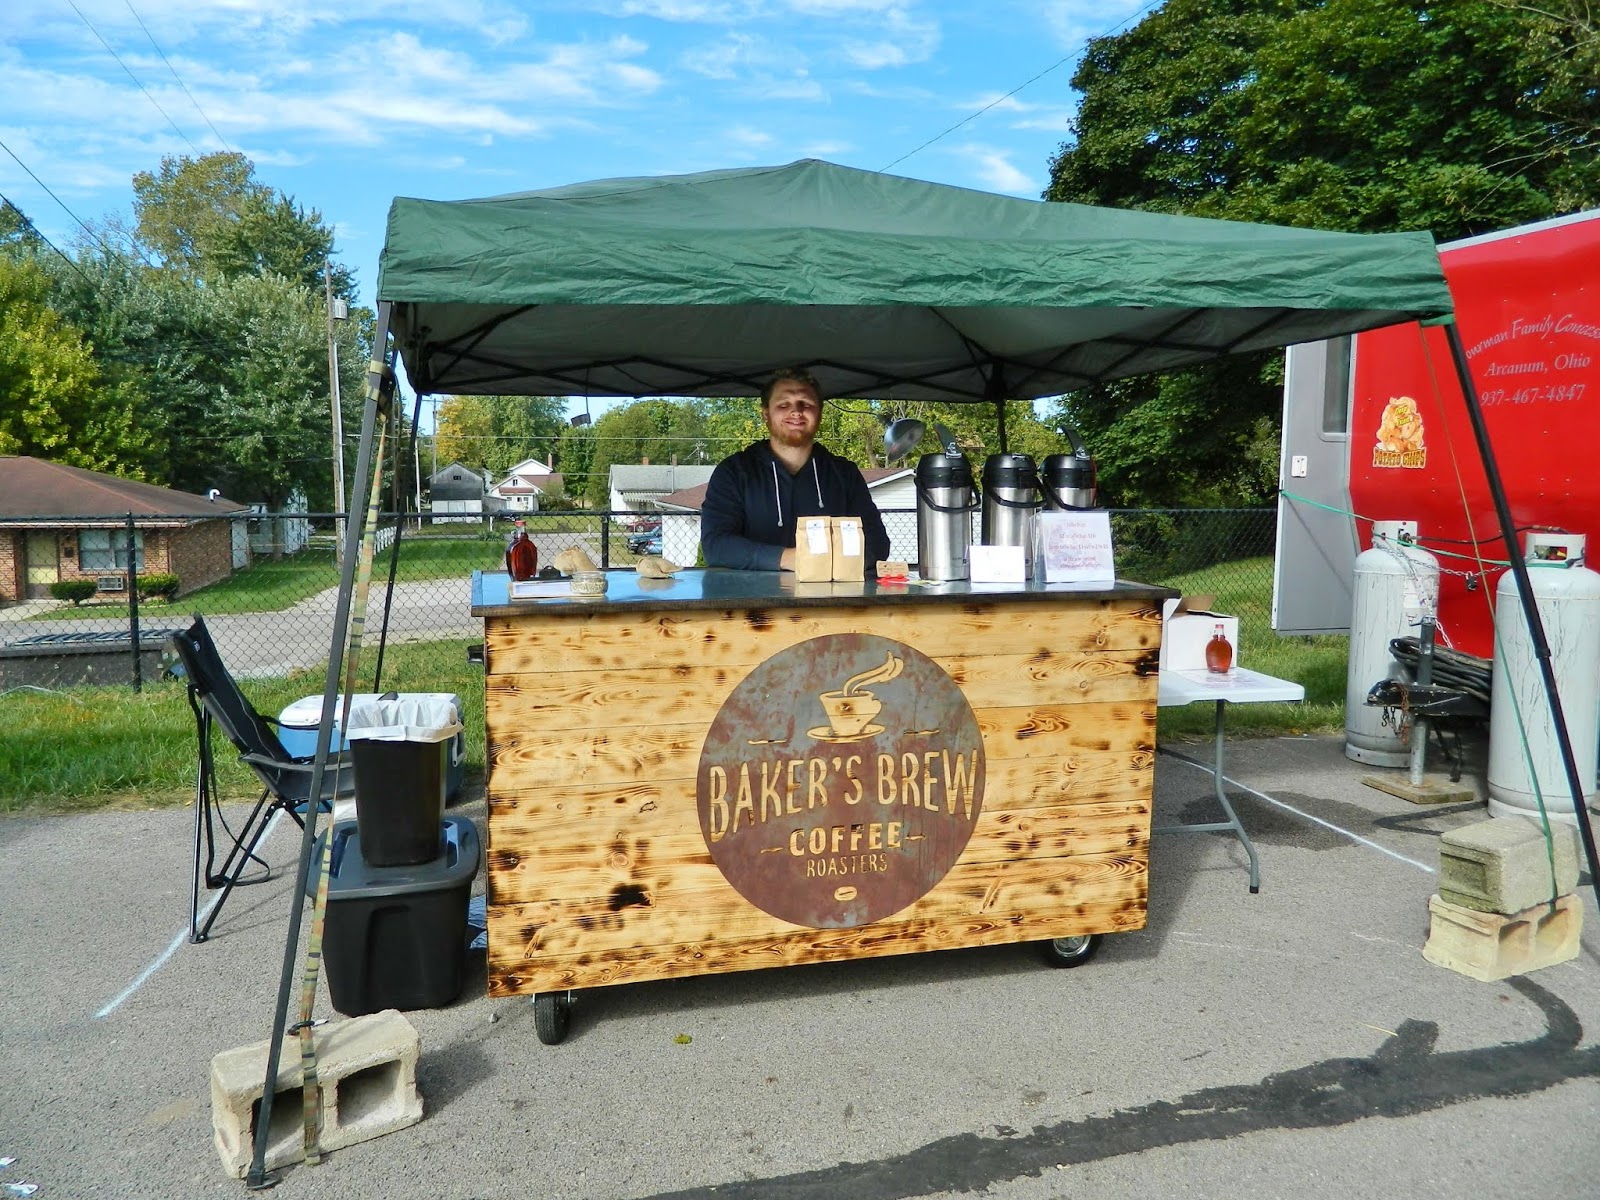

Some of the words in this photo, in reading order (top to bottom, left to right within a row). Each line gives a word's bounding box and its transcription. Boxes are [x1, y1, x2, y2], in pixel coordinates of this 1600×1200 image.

[1465, 331, 1509, 359] ourman
[1511, 314, 1553, 340] Family
[1483, 362, 1548, 377] Arcanum,
[1554, 353, 1591, 370] Ohio
[1480, 384, 1586, 406] 937-467-4847
[1374, 449, 1401, 466] POTATO
[1402, 449, 1425, 466] CHIPS
[709, 754, 863, 842] BAKER'S
[877, 749, 978, 821] BREW
[789, 822, 902, 856] COFFEE
[807, 853, 888, 877] ROASTERS
